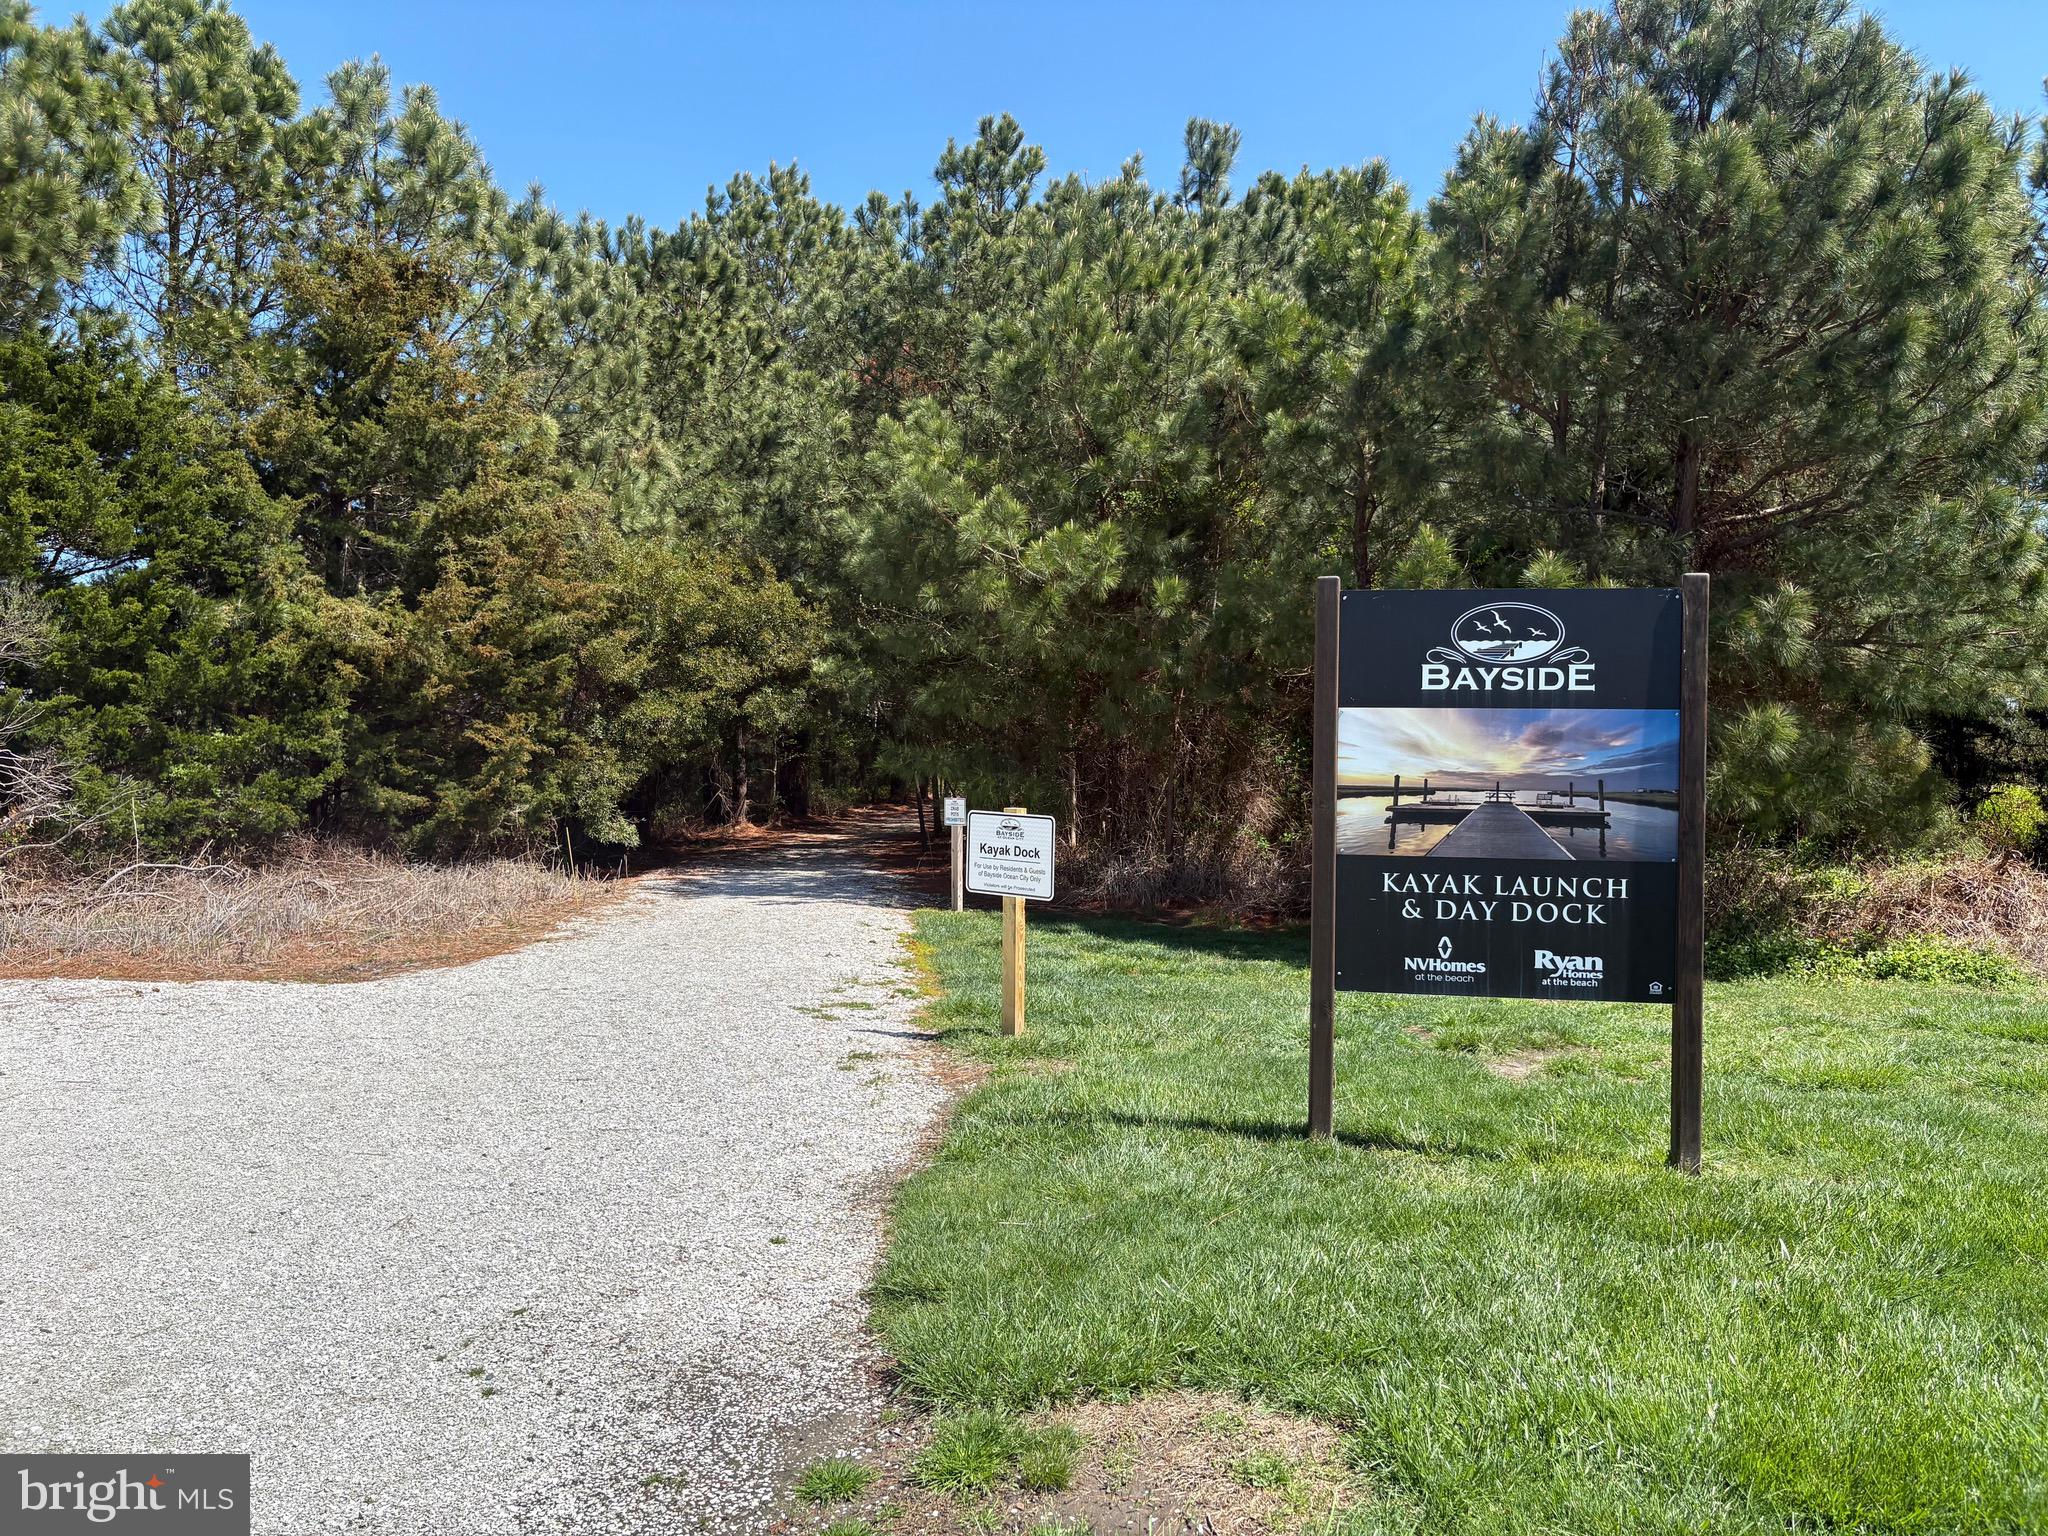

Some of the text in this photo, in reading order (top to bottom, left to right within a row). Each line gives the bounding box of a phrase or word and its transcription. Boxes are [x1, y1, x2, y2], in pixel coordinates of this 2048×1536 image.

[1421, 663, 1596, 691] BAYSIDE
[979, 842, 1041, 859] Kayak Dock
[984, 871, 1002, 879] Bayside
[1019, 874, 1029, 883] City
[1029, 875, 1042, 883] Only
[1000, 865, 1023, 873] Residents
[1382, 872, 1629, 899] KAYAK LAUNCH
[1401, 898, 1607, 925] & DAY DOCK
[1404, 957, 1486, 974] NVHomes
[1534, 950, 1603, 978] Ryan
[1415, 973, 1475, 983] at the beach
[1553, 978, 1568, 986] the
[1570, 978, 1598, 988] beach
[1562, 970, 1603, 979] Homes
